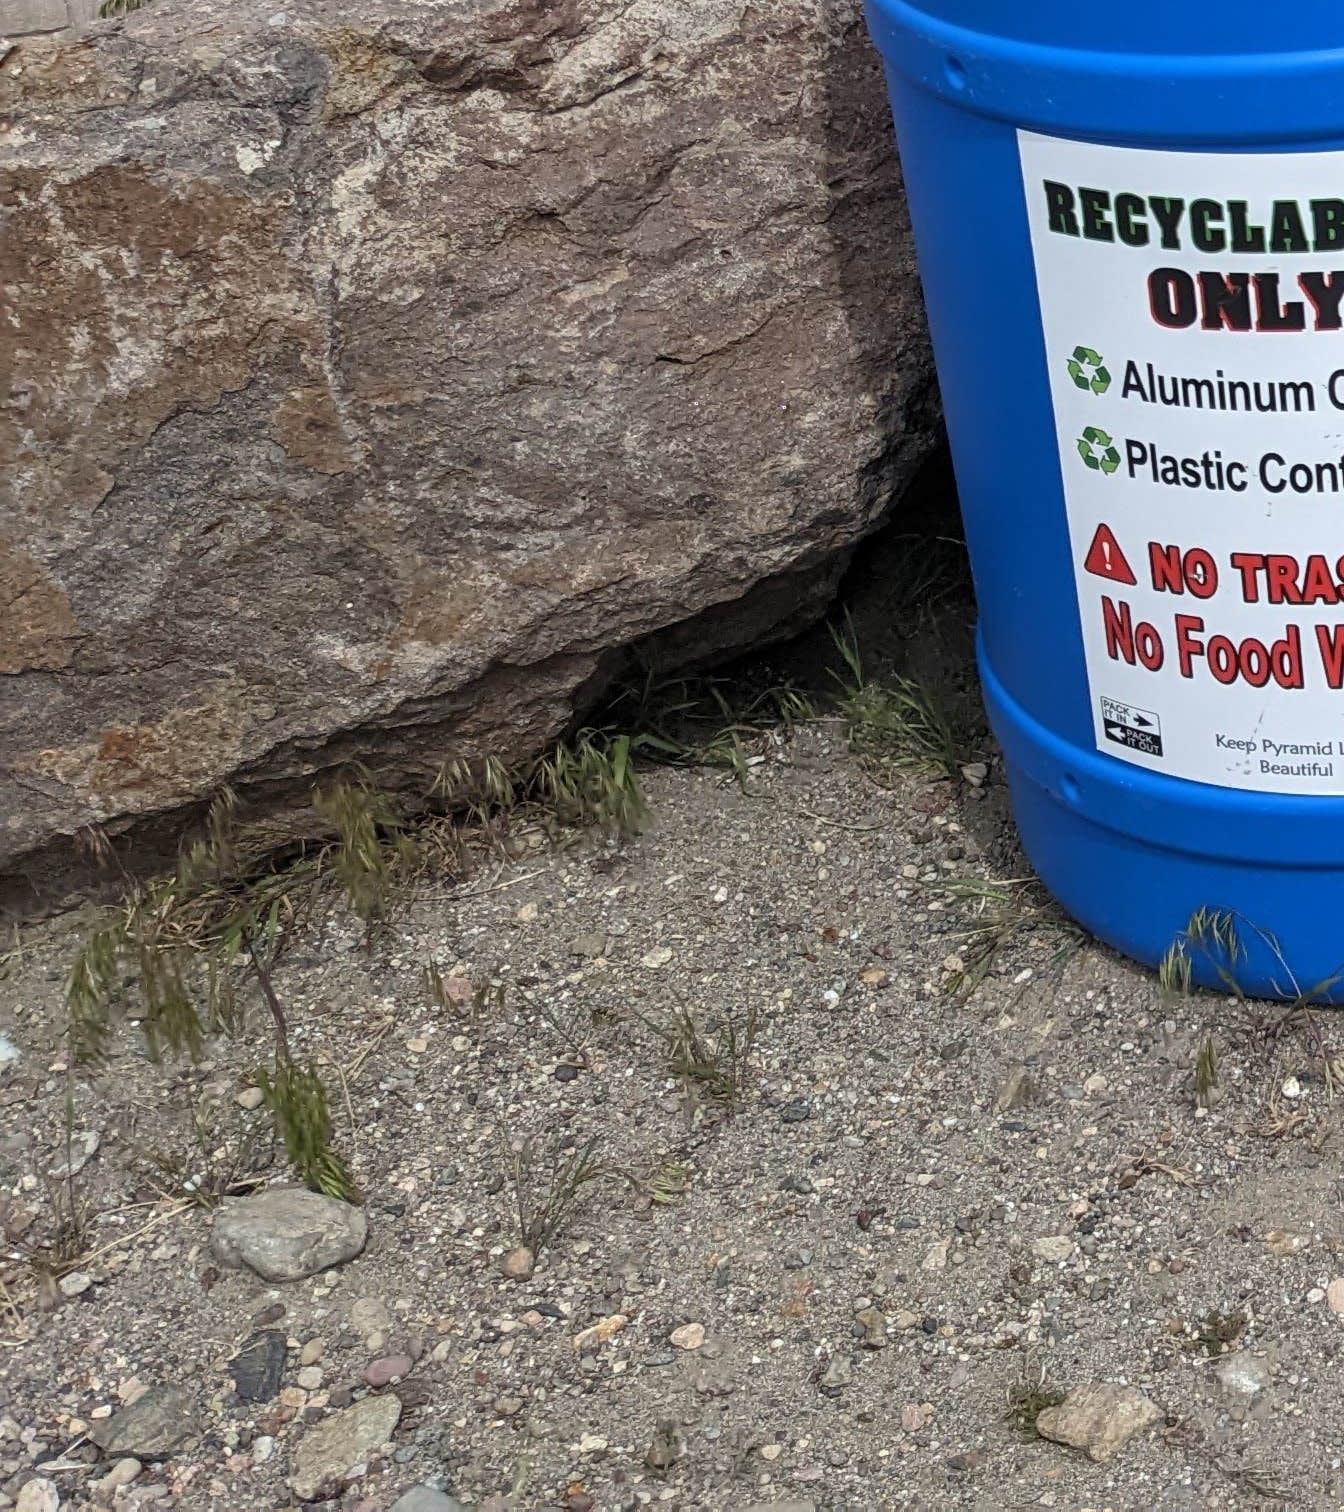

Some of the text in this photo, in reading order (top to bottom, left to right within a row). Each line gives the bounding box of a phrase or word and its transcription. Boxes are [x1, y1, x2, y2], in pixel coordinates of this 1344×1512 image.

[1121, 359, 1316, 412] Aluminum
[1124, 438, 1248, 492] Plastic
[1148, 541, 1219, 600] NO
[1101, 595, 1164, 672] No
[1175, 613, 1305, 690] Food
[1103, 699, 1130, 716] PACK
[1126, 729, 1153, 744] PACK
[1138, 741, 1160, 754] OUT
[1215, 733, 1257, 754] Keep
[1262, 738, 1333, 757] Pyramid
[1259, 759, 1334, 777] Beautiful
